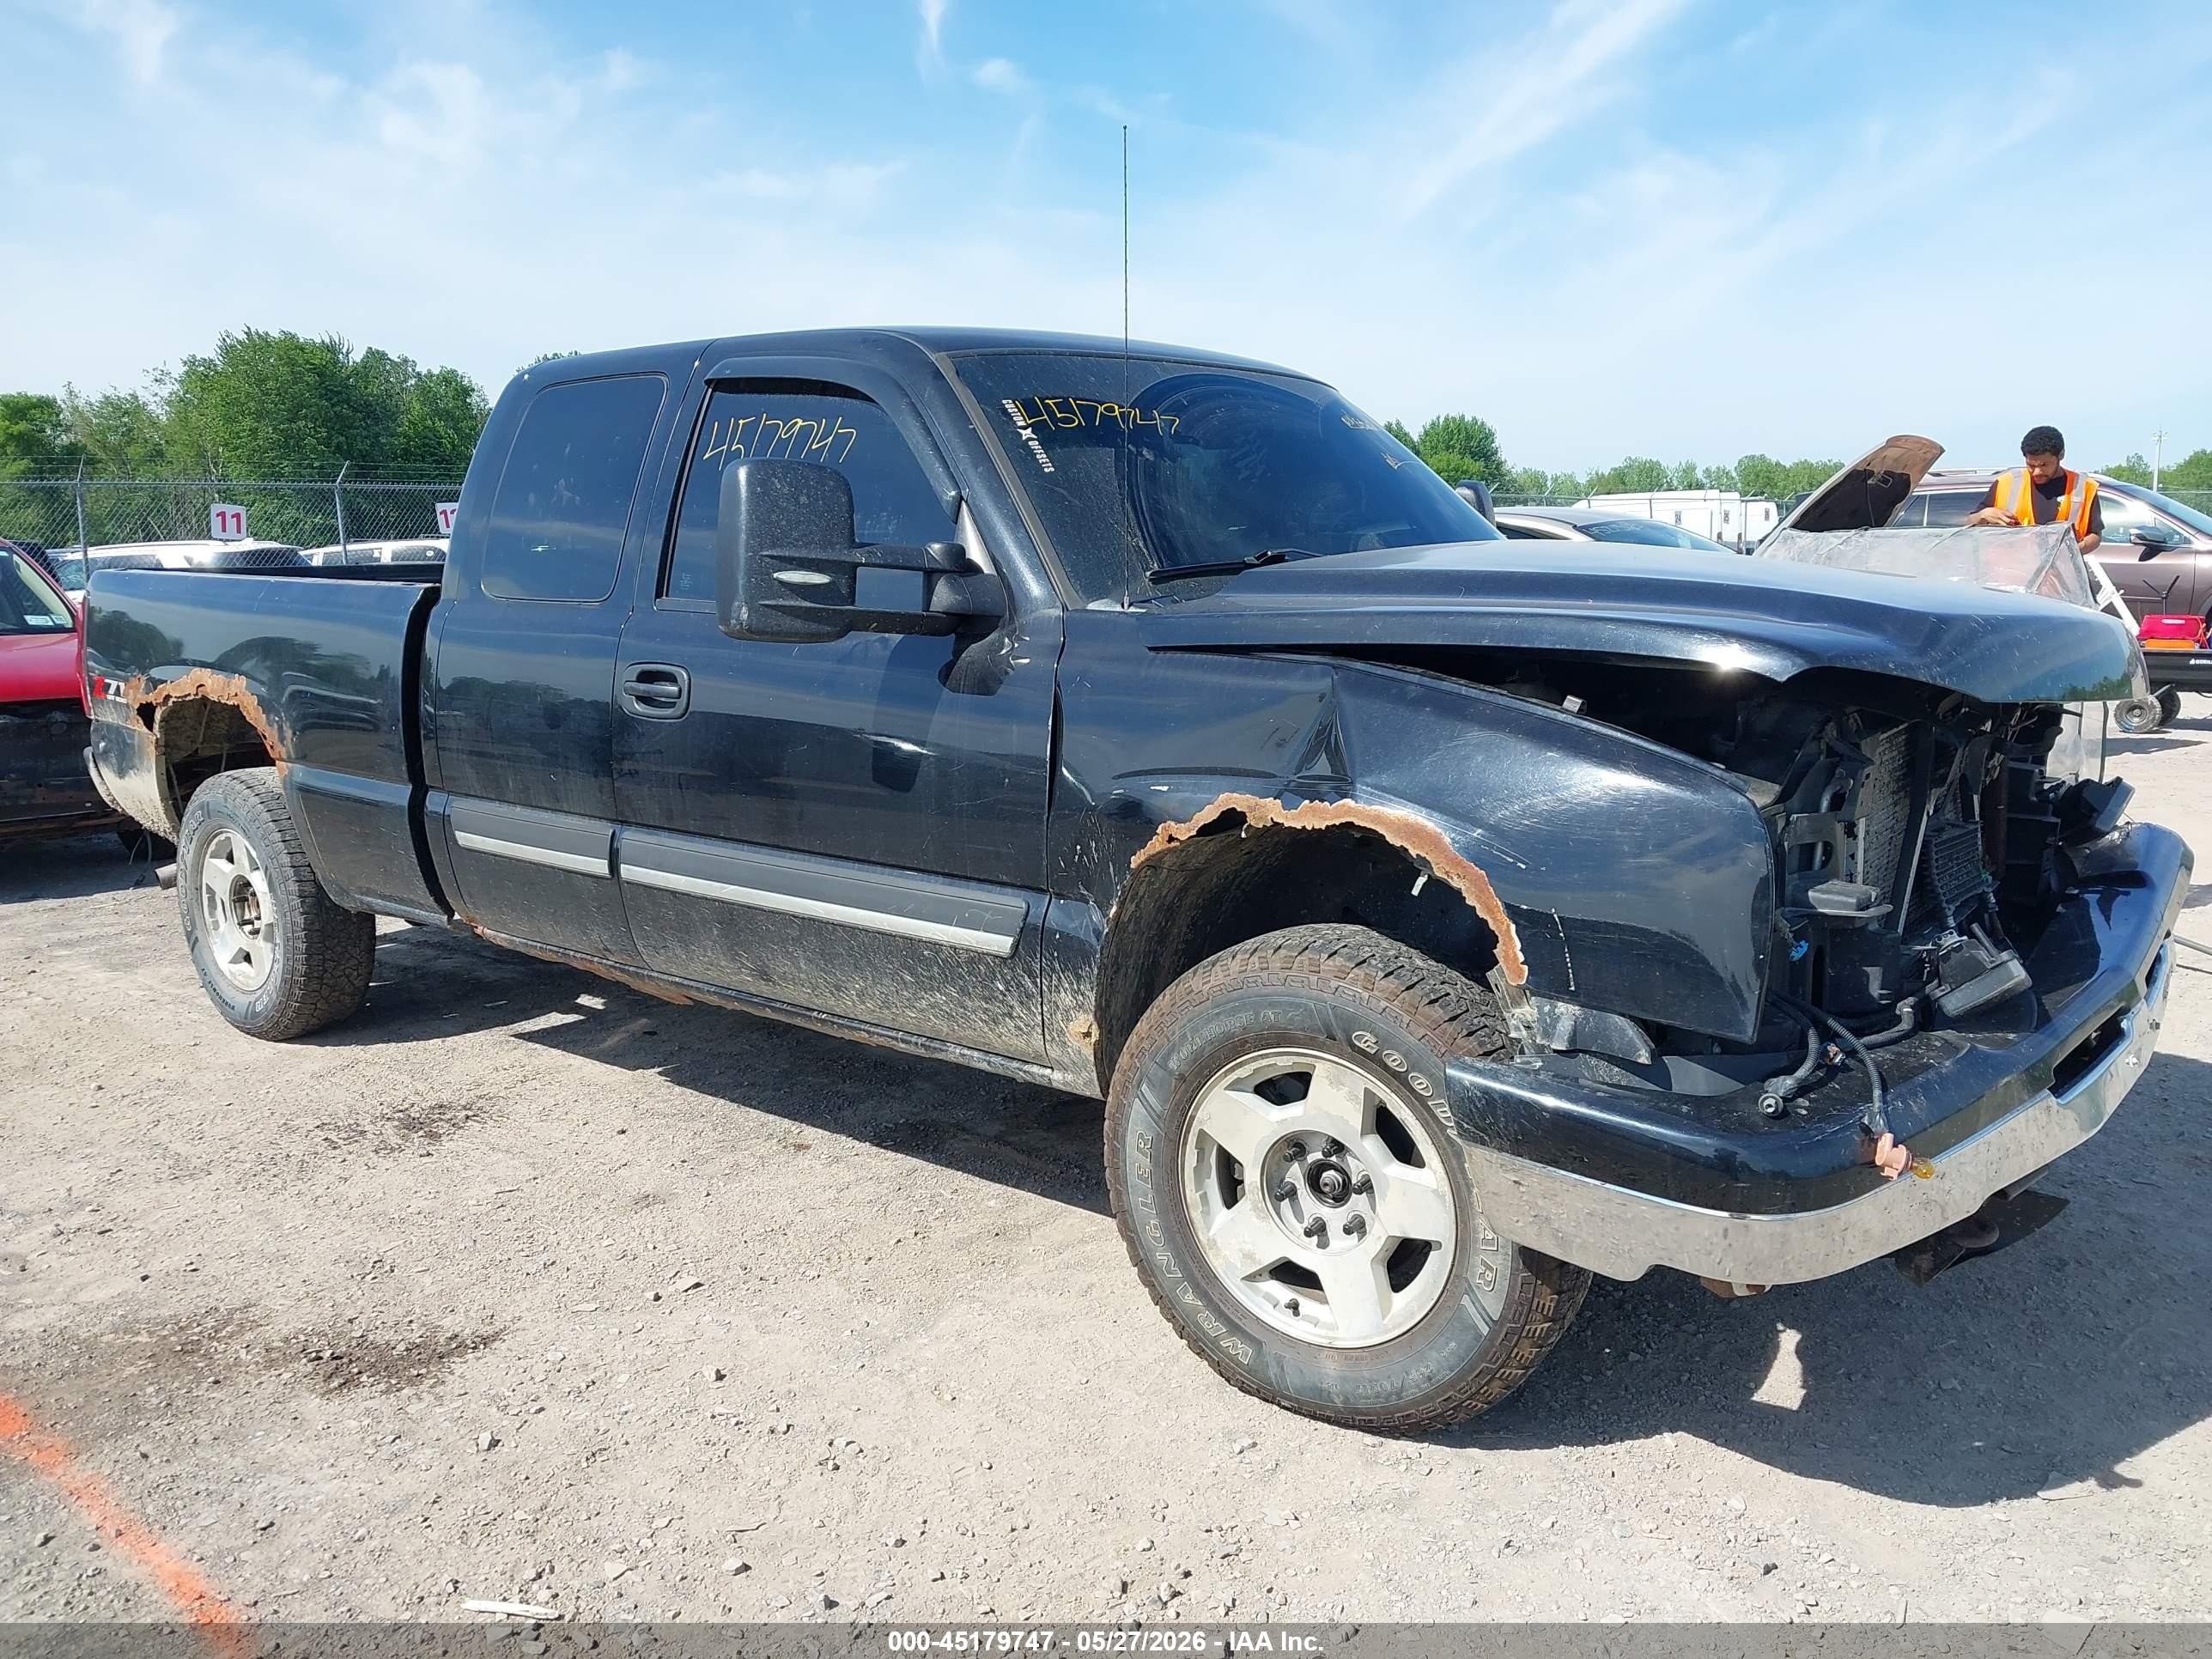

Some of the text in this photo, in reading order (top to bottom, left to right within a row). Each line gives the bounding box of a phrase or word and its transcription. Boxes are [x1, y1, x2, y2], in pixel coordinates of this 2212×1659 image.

[702, 413, 857, 471] 45179747
[1001, 398, 1055, 473] CUSTOM OFFSETS
[1014, 396, 1180, 436] 45179747
[216, 510, 242, 535] 11
[1166, 1010, 1282, 1071] WORKHORSE AT
[1352, 1030, 1499, 1292] GOODAR
[1135, 1130, 1255, 1365] WRANGLER
